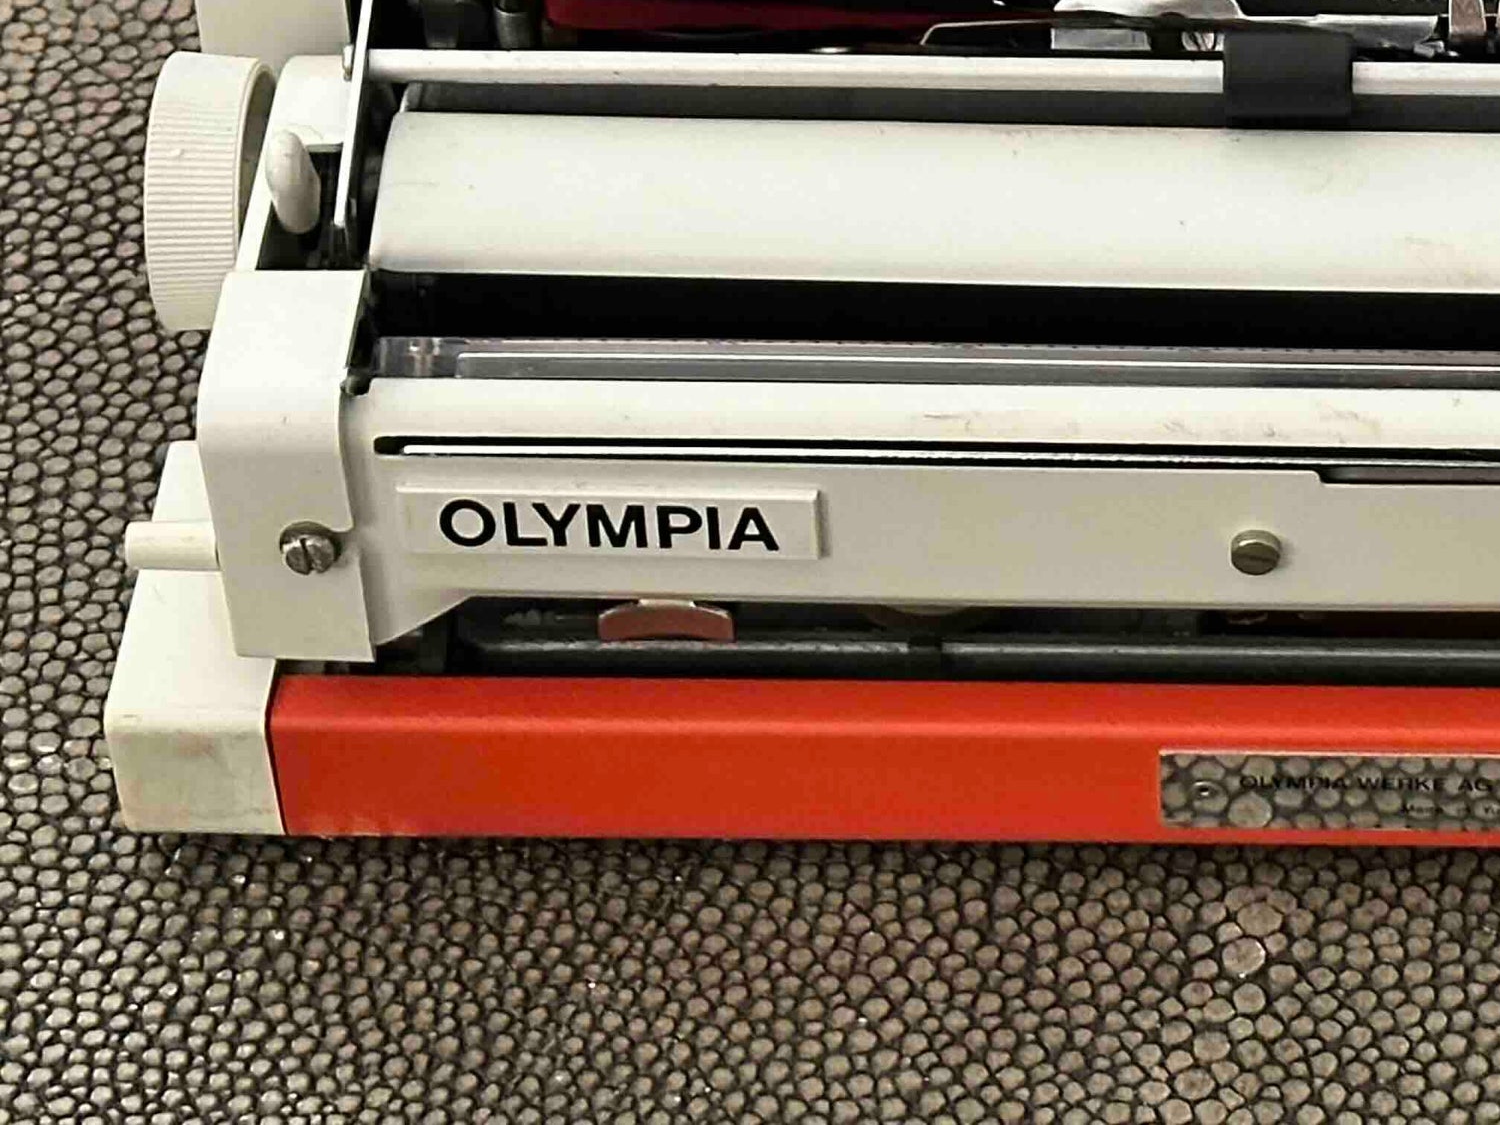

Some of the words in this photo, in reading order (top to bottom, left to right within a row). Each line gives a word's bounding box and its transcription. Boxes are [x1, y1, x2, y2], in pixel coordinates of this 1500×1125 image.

[438, 498, 780, 552] OLYMPIA
[1239, 776, 1349, 790] OLYMPIA
[1357, 777, 1446, 791] WERKE
[1458, 778, 1494, 793] AG
